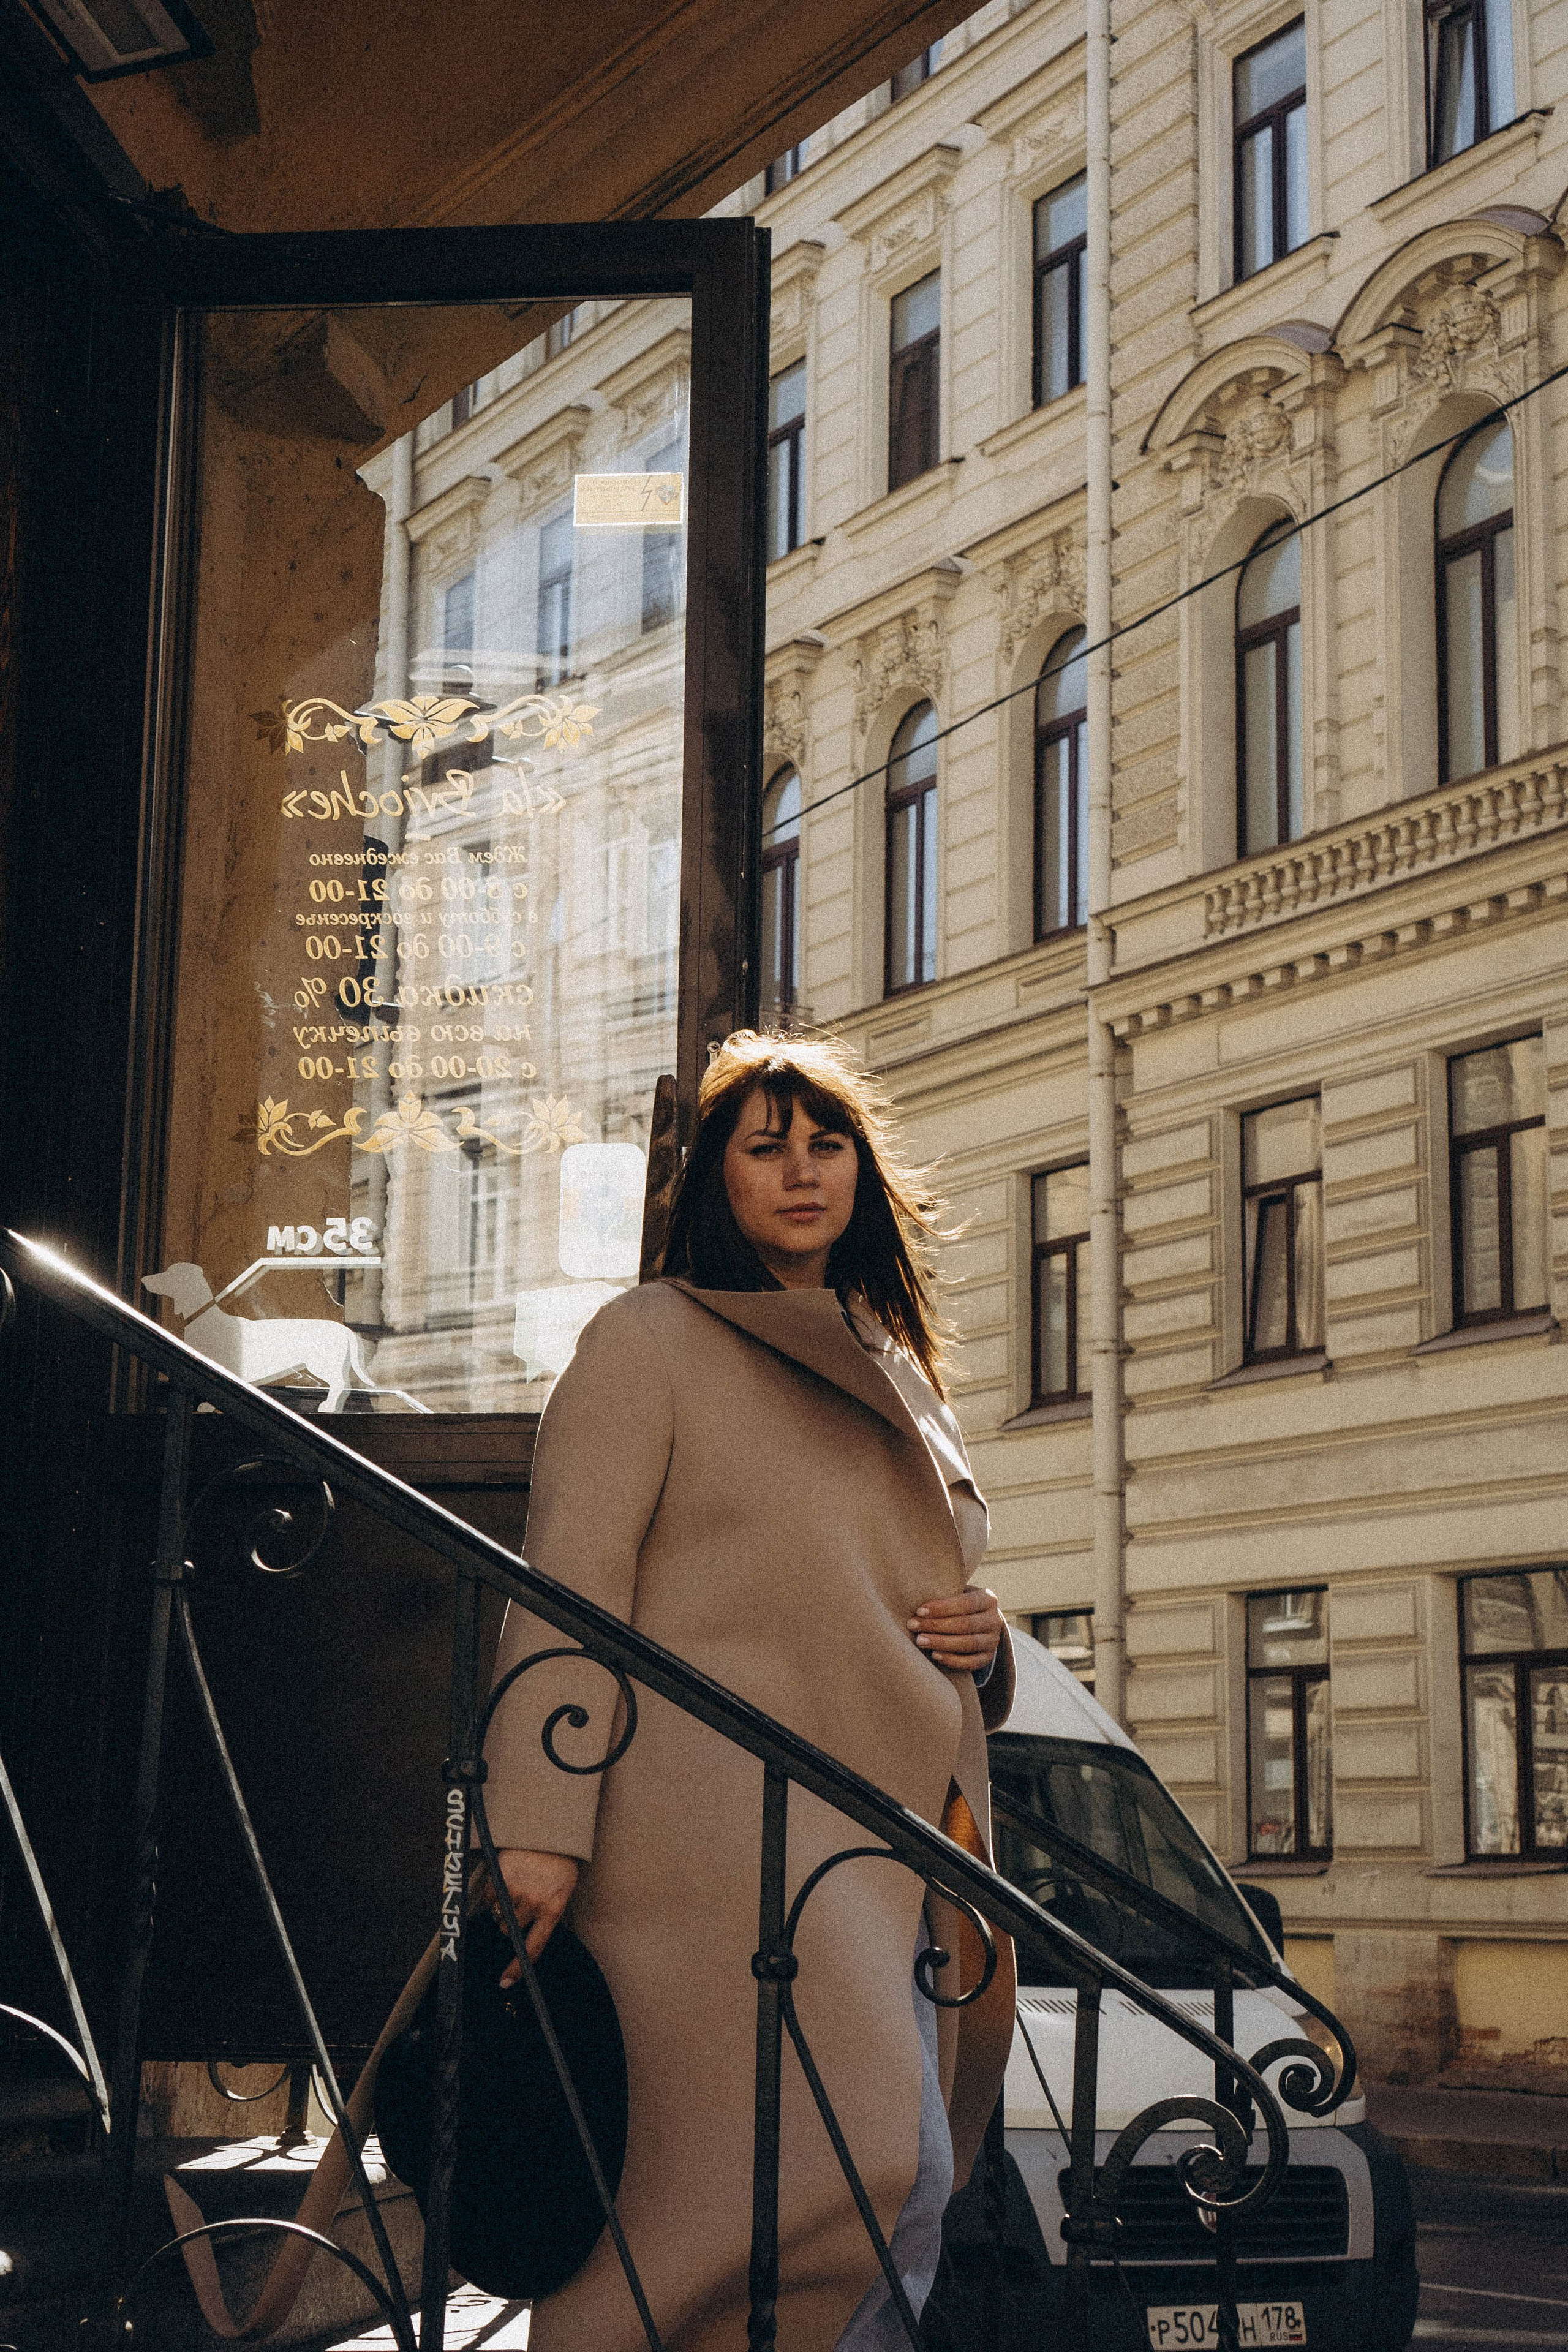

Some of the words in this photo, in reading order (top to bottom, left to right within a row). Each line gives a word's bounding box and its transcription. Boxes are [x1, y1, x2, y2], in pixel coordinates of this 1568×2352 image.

[1157, 2310, 1256, 2345] Р504Н
[1261, 2305, 1297, 2330] 178
[1270, 2331, 1288, 2342] RUS
